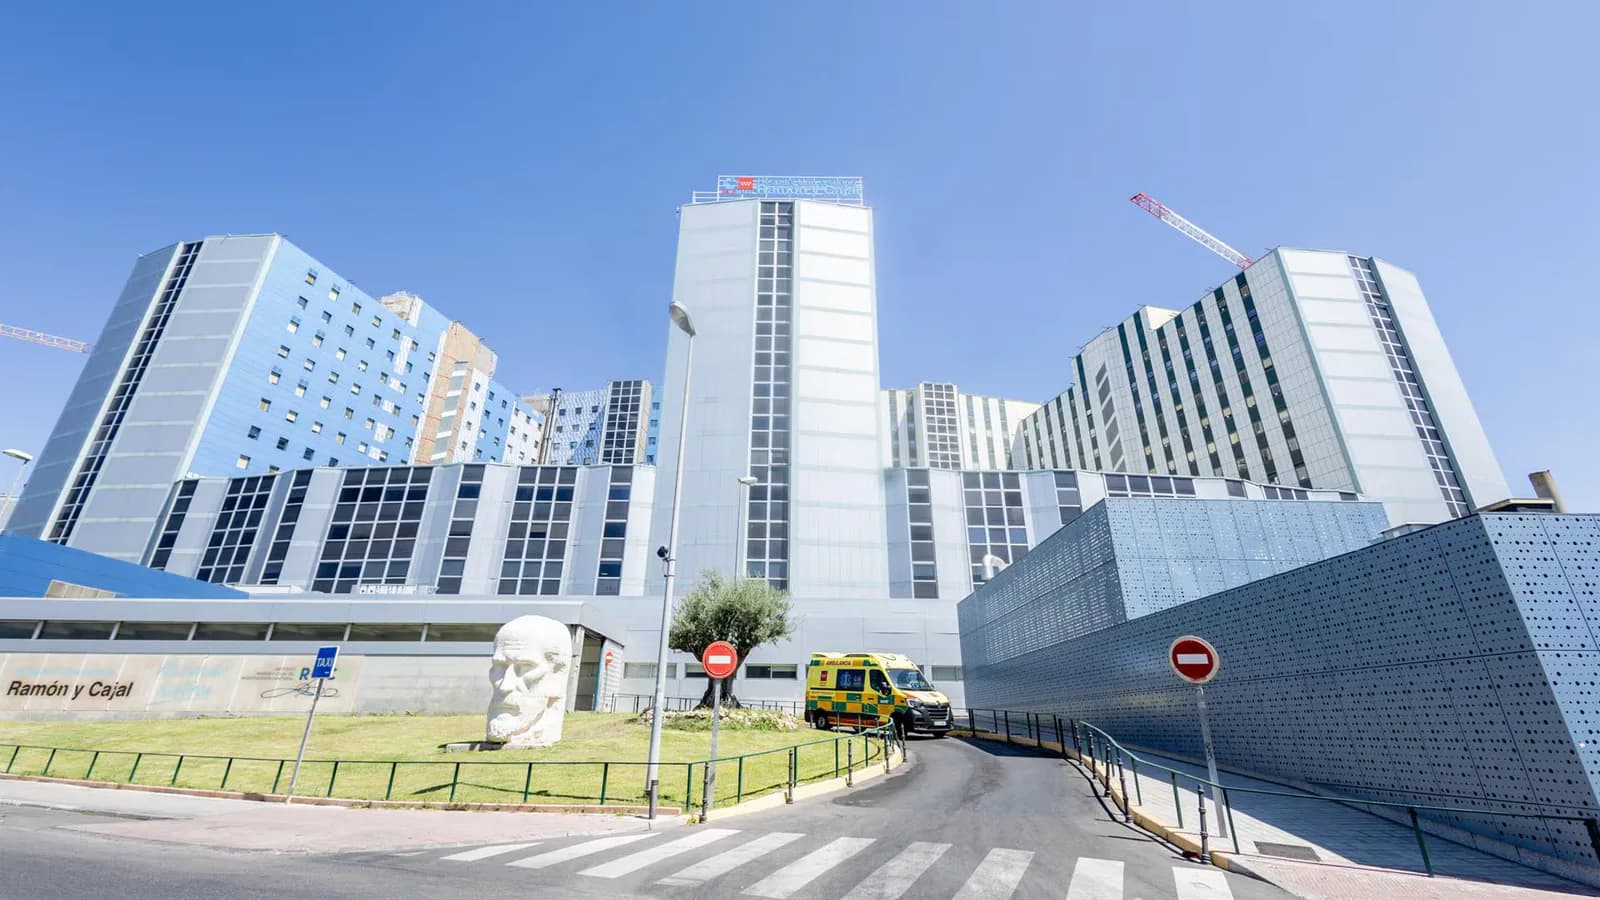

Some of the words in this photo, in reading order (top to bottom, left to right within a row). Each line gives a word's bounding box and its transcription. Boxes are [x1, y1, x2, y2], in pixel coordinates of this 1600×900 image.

[316, 657, 333, 667] TAXI
[7, 680, 69, 697] Ramón
[71, 684, 85, 701] y
[89, 681, 134, 701] Cajal
